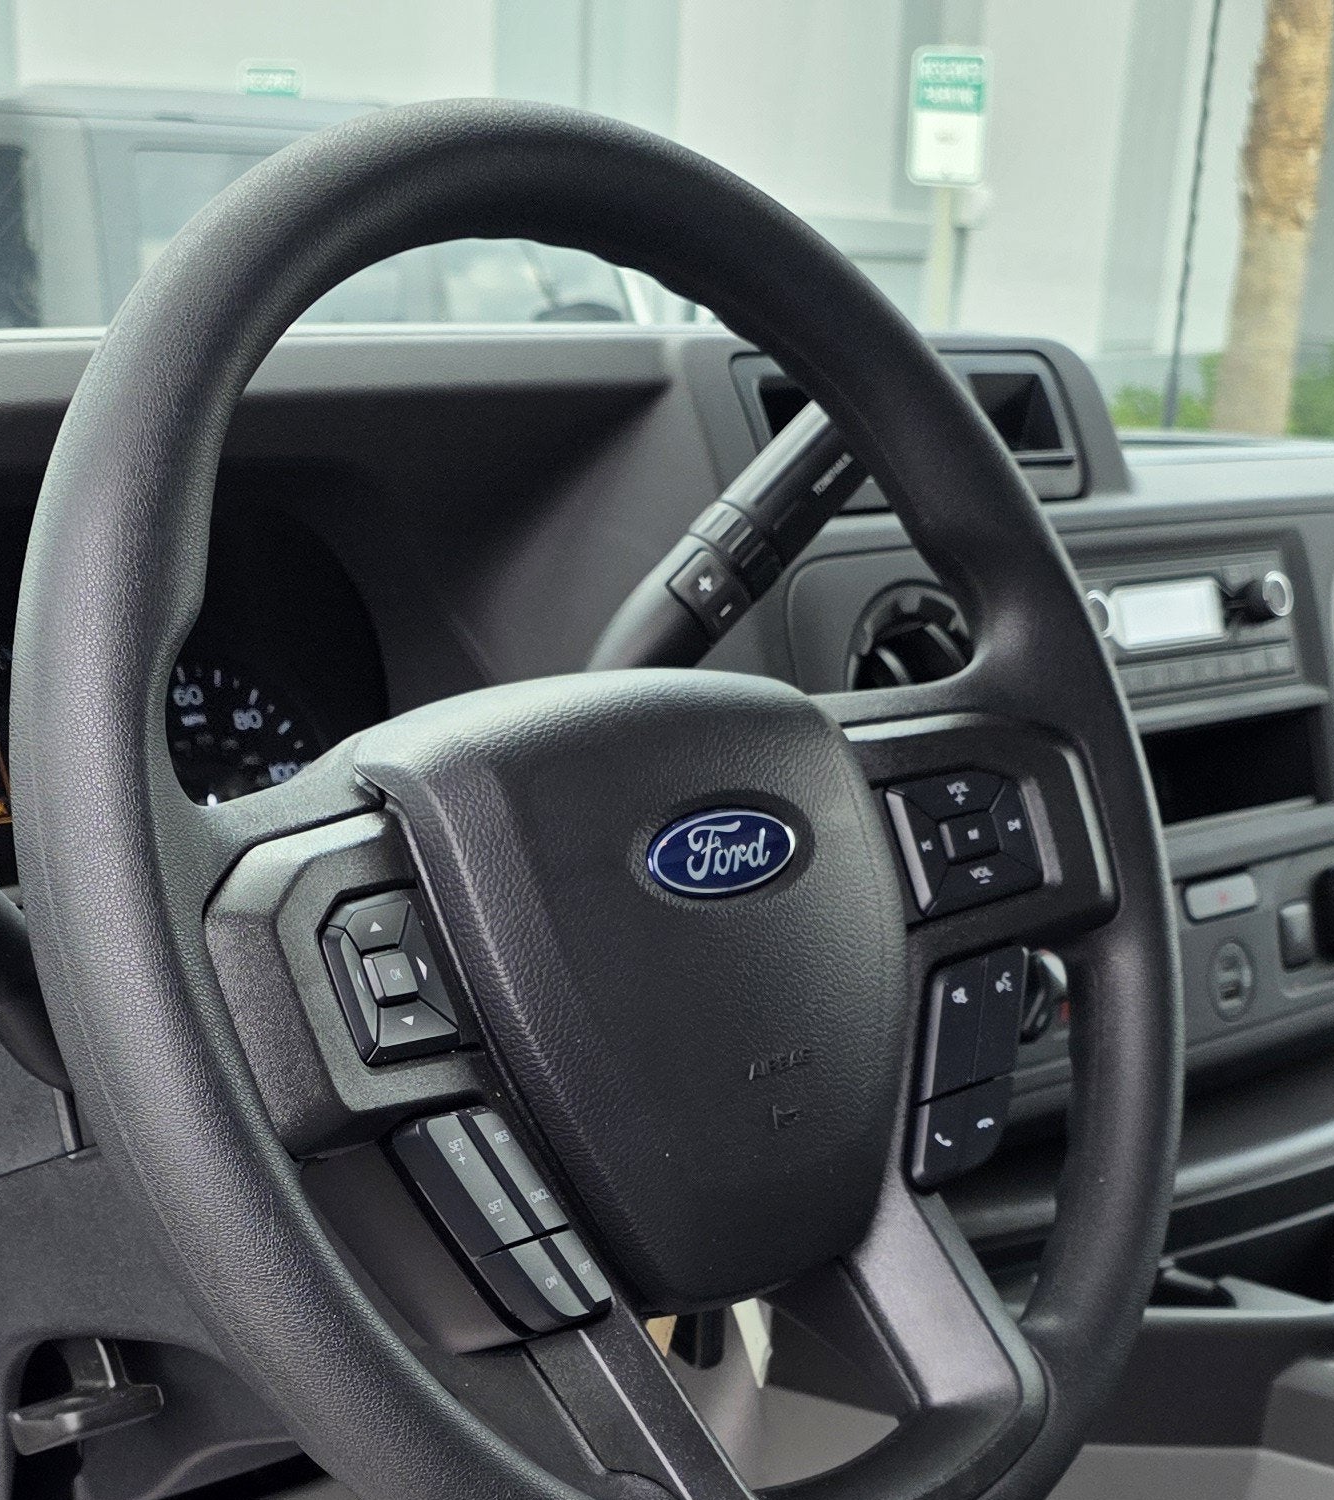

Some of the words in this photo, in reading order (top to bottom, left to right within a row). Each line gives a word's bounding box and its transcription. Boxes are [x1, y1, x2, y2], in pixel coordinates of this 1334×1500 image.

[173, 684, 204, 706] 60
[686, 819, 771, 881] Ford
[389, 968, 404, 982] OK
[493, 1130, 510, 1144] RES
[448, 1138, 465, 1154] SET
[529, 1188, 550, 1203] CNCL
[487, 1199, 504, 1215] SET
[577, 1259, 593, 1275] OFF
[544, 1274, 559, 1290] ON
